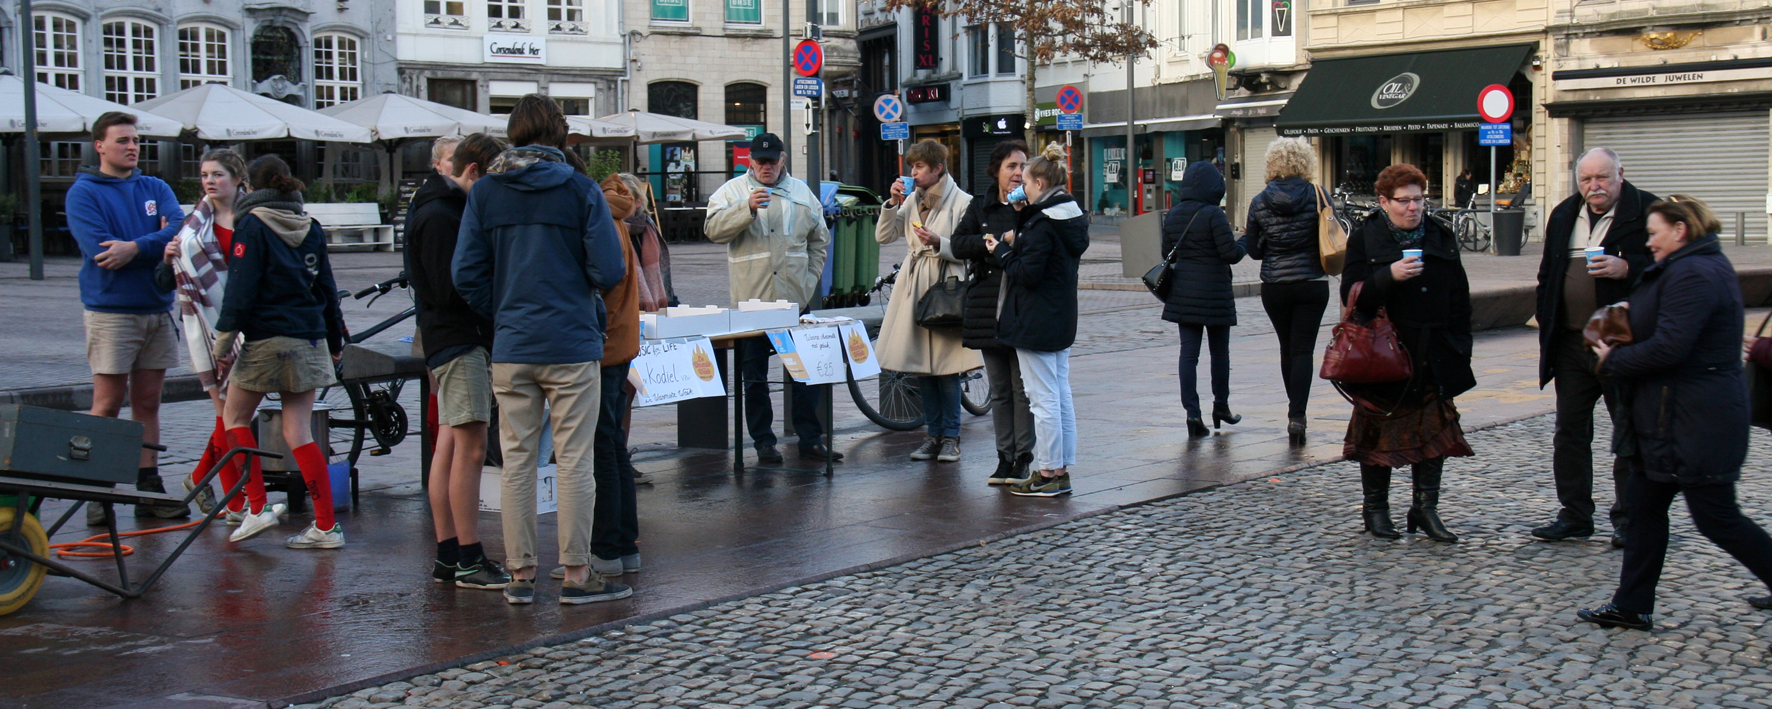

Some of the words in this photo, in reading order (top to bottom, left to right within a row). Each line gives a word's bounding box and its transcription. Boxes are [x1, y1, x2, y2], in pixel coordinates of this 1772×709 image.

[529, 42, 541, 55] bier
[919, 54, 936, 66] XL
[1630, 76, 1656, 84] WILDE
[1664, 73, 1704, 83] JUWELEN
[1383, 82, 1403, 94] OIL
[662, 343, 678, 353] LIFE
[645, 363, 679, 385] Kodiel
